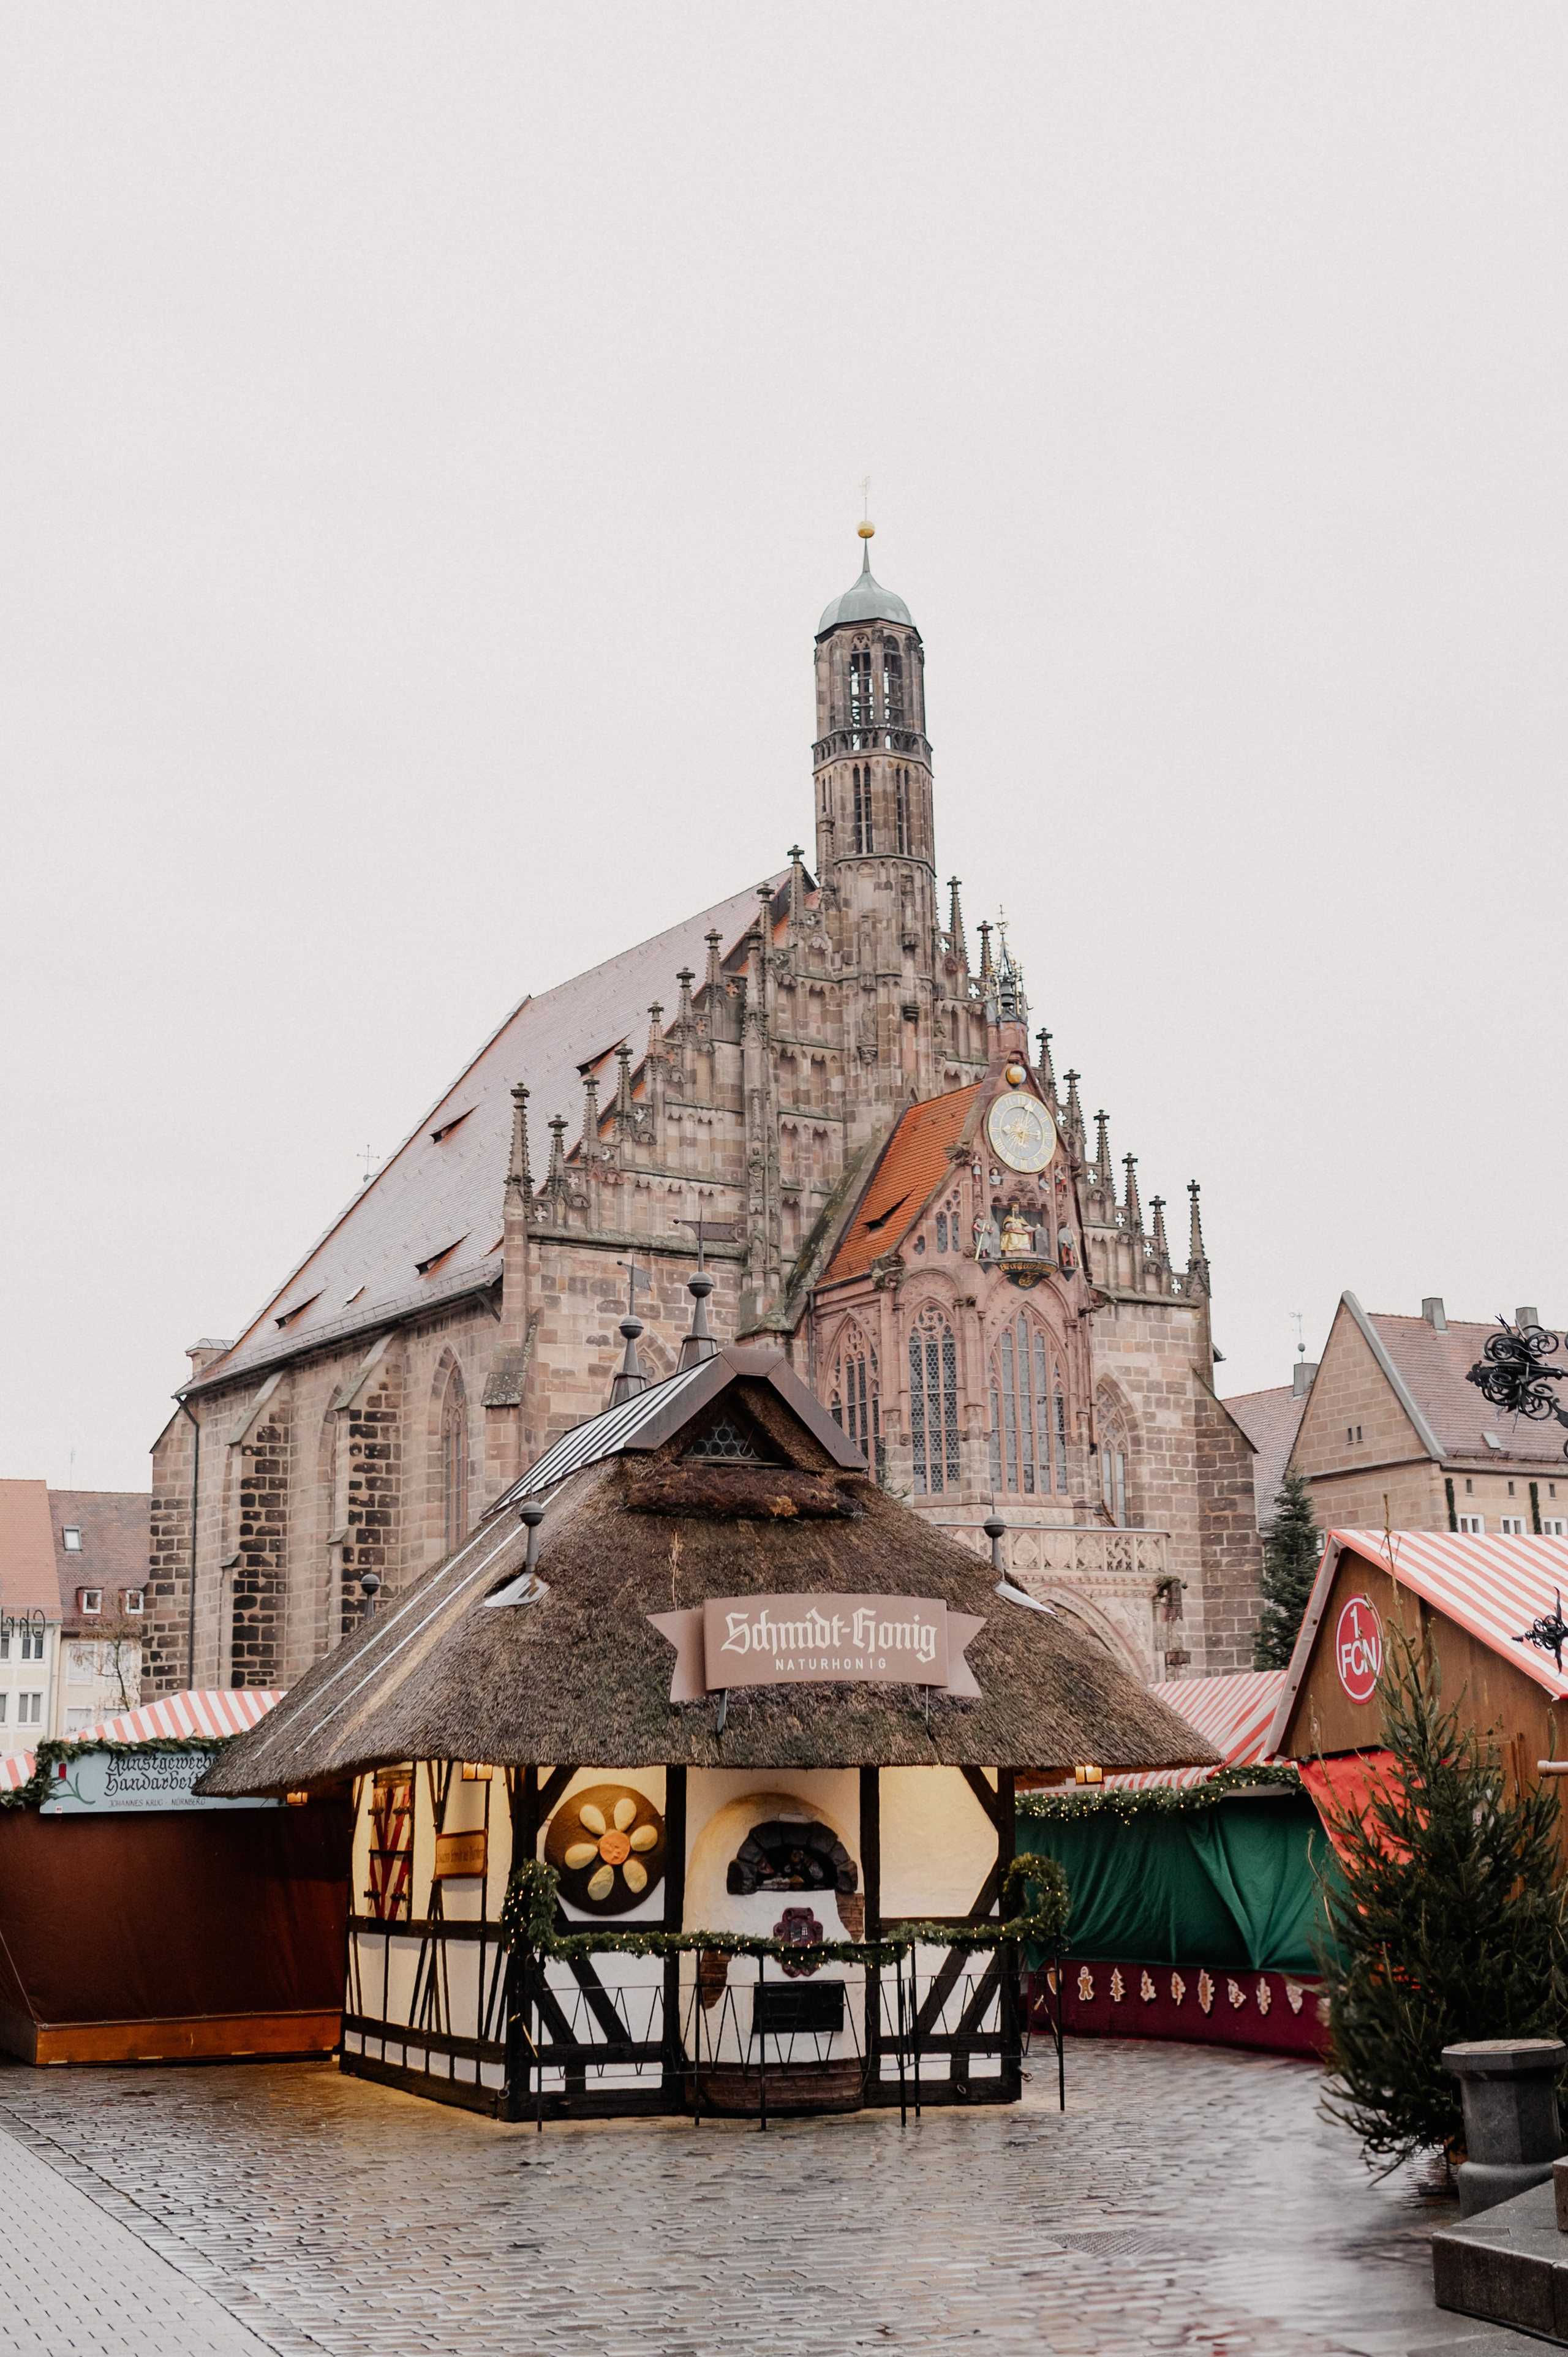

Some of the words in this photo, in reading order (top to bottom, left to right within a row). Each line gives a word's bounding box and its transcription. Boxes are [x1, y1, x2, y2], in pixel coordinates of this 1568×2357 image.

[721, 1606, 938, 1663] Schmidt-Honig
[1350, 1605, 1359, 1639] 1
[775, 1657, 886, 1671] NATURHONIG
[1341, 1636, 1377, 1678] FCN
[108, 1799, 143, 1808] JOHANNES
